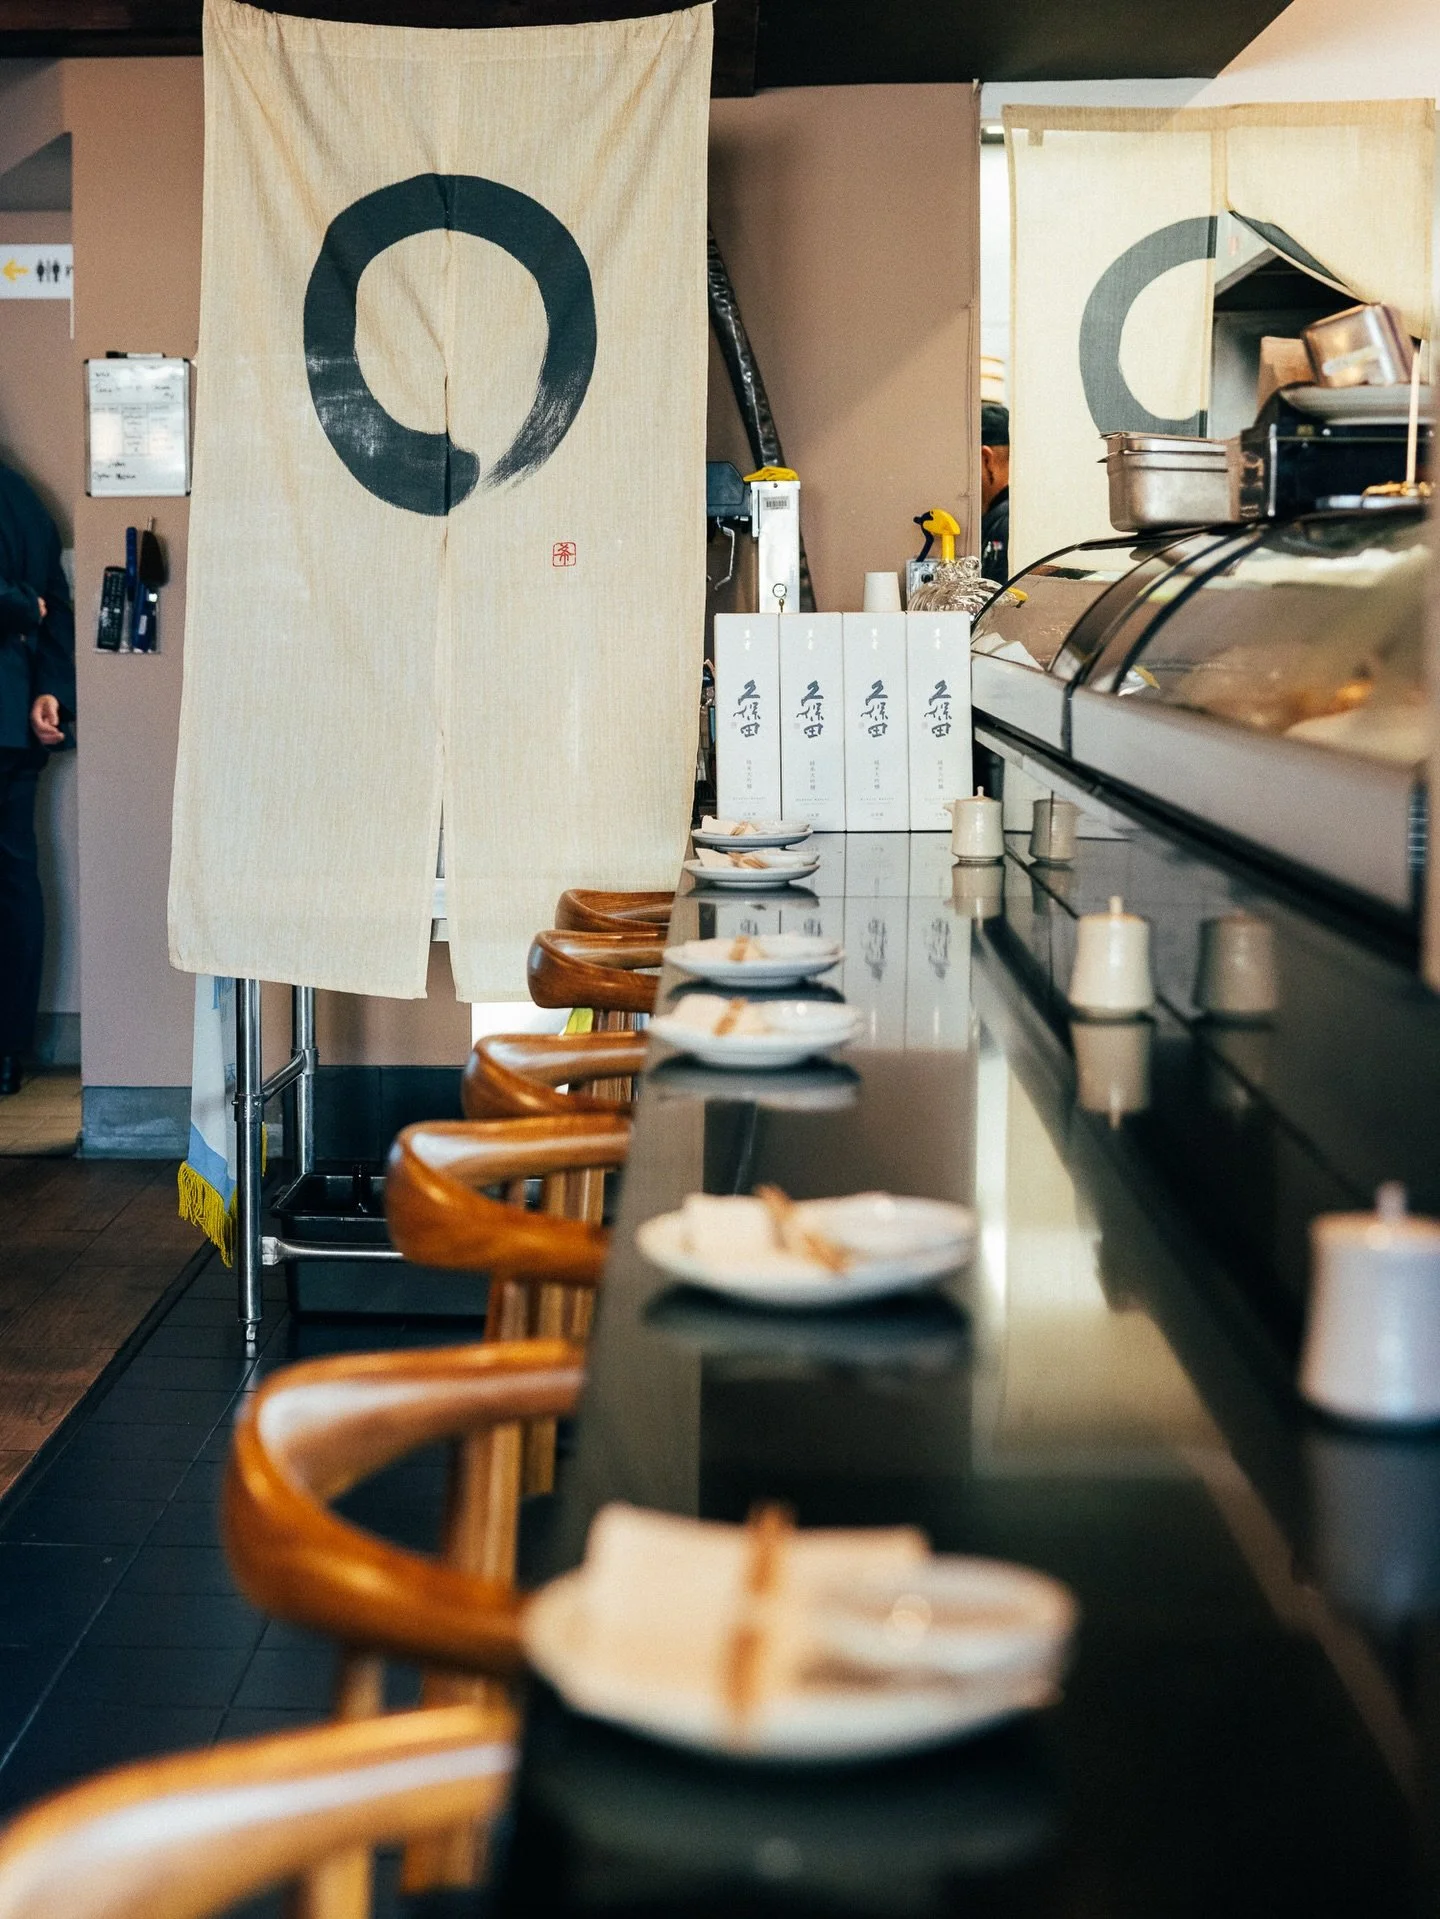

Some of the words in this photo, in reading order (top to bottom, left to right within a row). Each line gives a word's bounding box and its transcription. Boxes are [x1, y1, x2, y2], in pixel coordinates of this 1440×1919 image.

[733, 679, 761, 738] 久保田
[796, 680, 824, 738] 久保田
[861, 679, 889, 738] 久保田
[924, 679, 952, 738] 久保田
